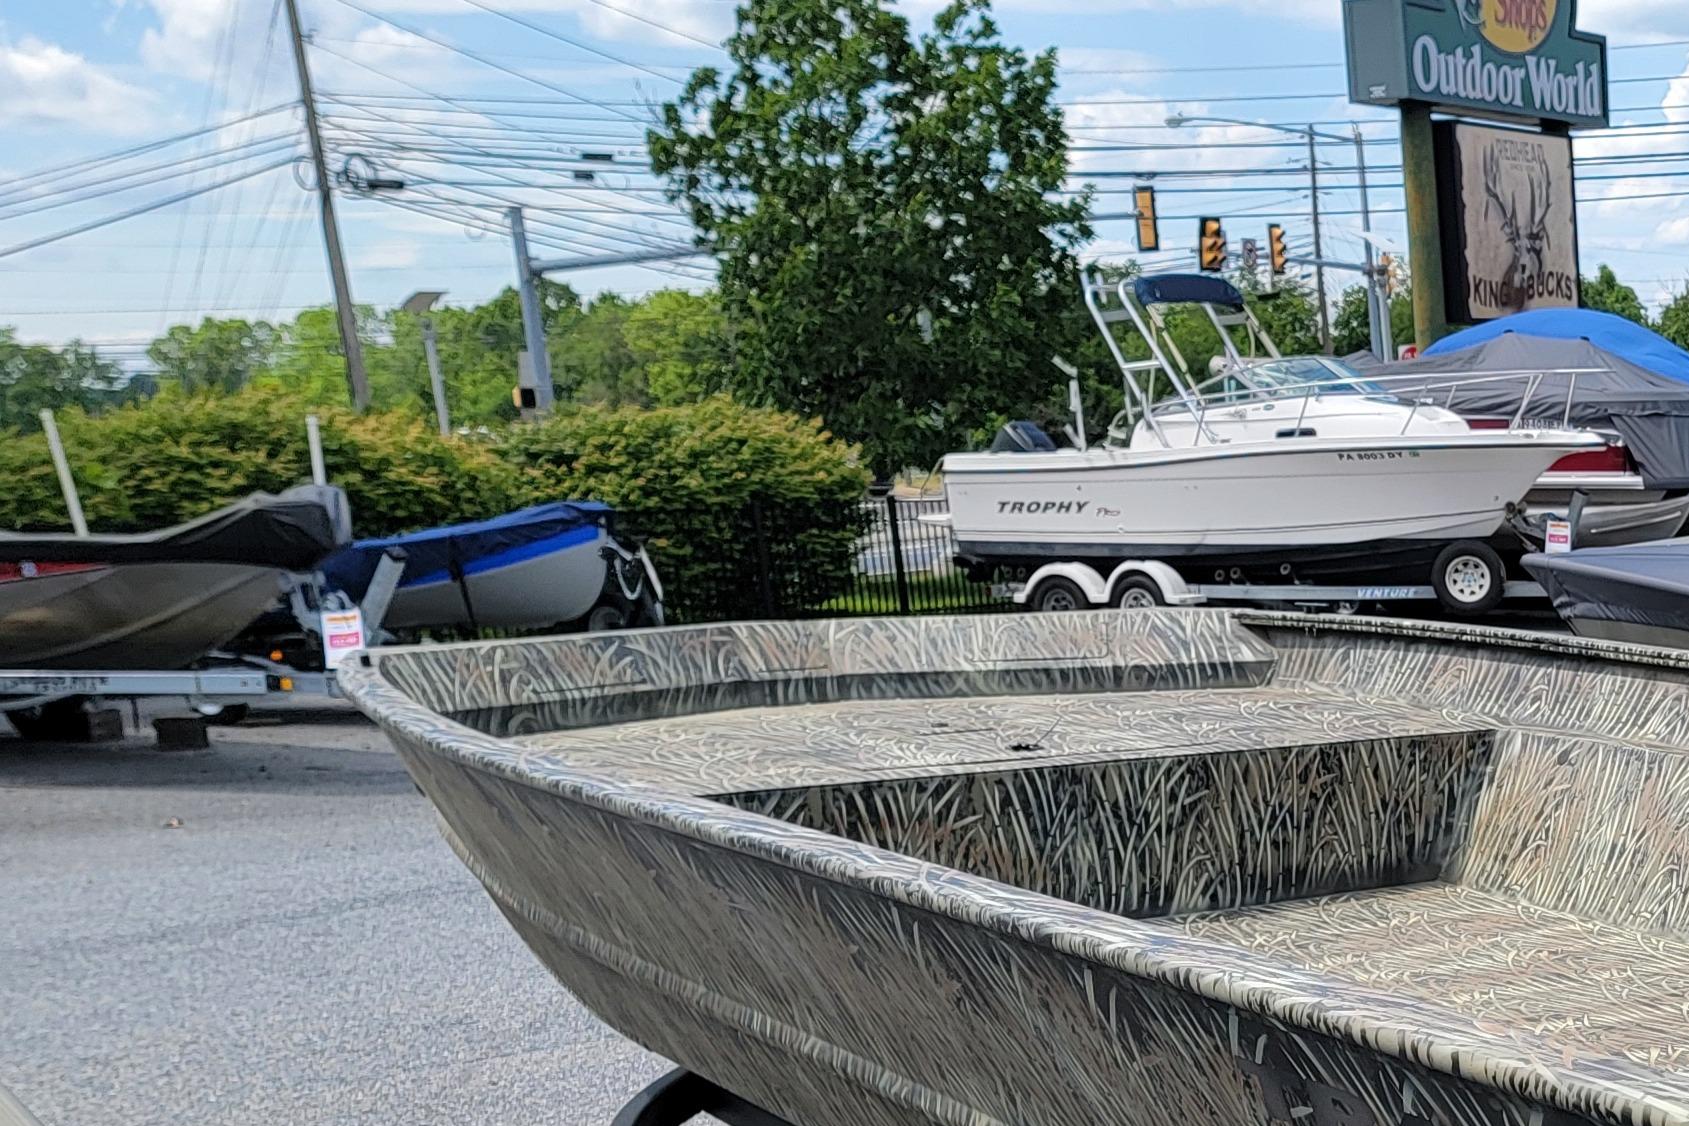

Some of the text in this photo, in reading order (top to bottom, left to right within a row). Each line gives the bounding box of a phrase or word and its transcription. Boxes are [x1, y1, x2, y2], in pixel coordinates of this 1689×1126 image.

[1412, 34, 1601, 117] Outdoor World
[1472, 270, 1574, 309] KING BUCKS
[1337, 453, 1354, 461] PA
[997, 501, 1091, 514] TROPHY
[1357, 587, 1417, 599] VENTURE
